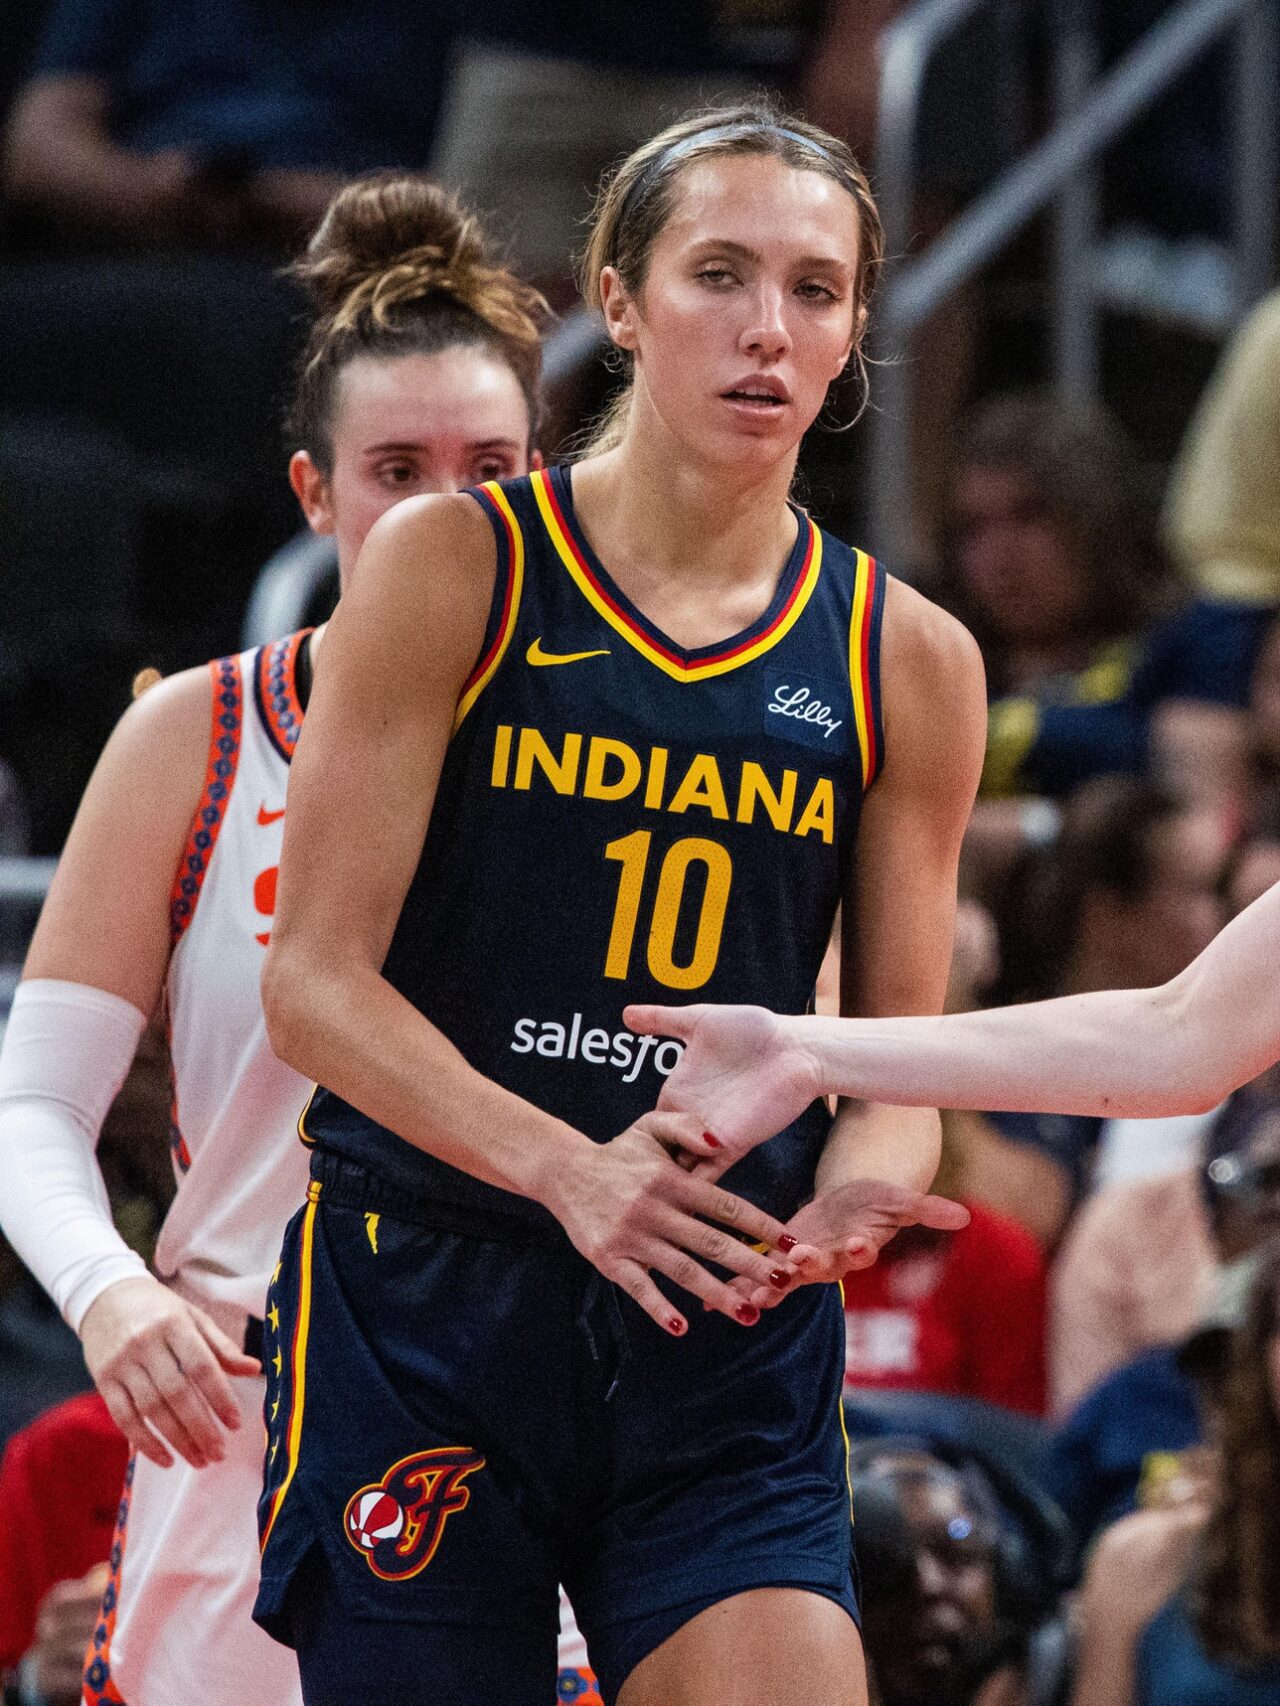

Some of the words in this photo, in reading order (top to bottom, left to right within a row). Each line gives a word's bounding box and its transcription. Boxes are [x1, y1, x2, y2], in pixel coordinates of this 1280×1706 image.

[768, 684, 842, 739] Lilly
[490, 724, 837, 845] INDIANA
[604, 828, 733, 990] 10
